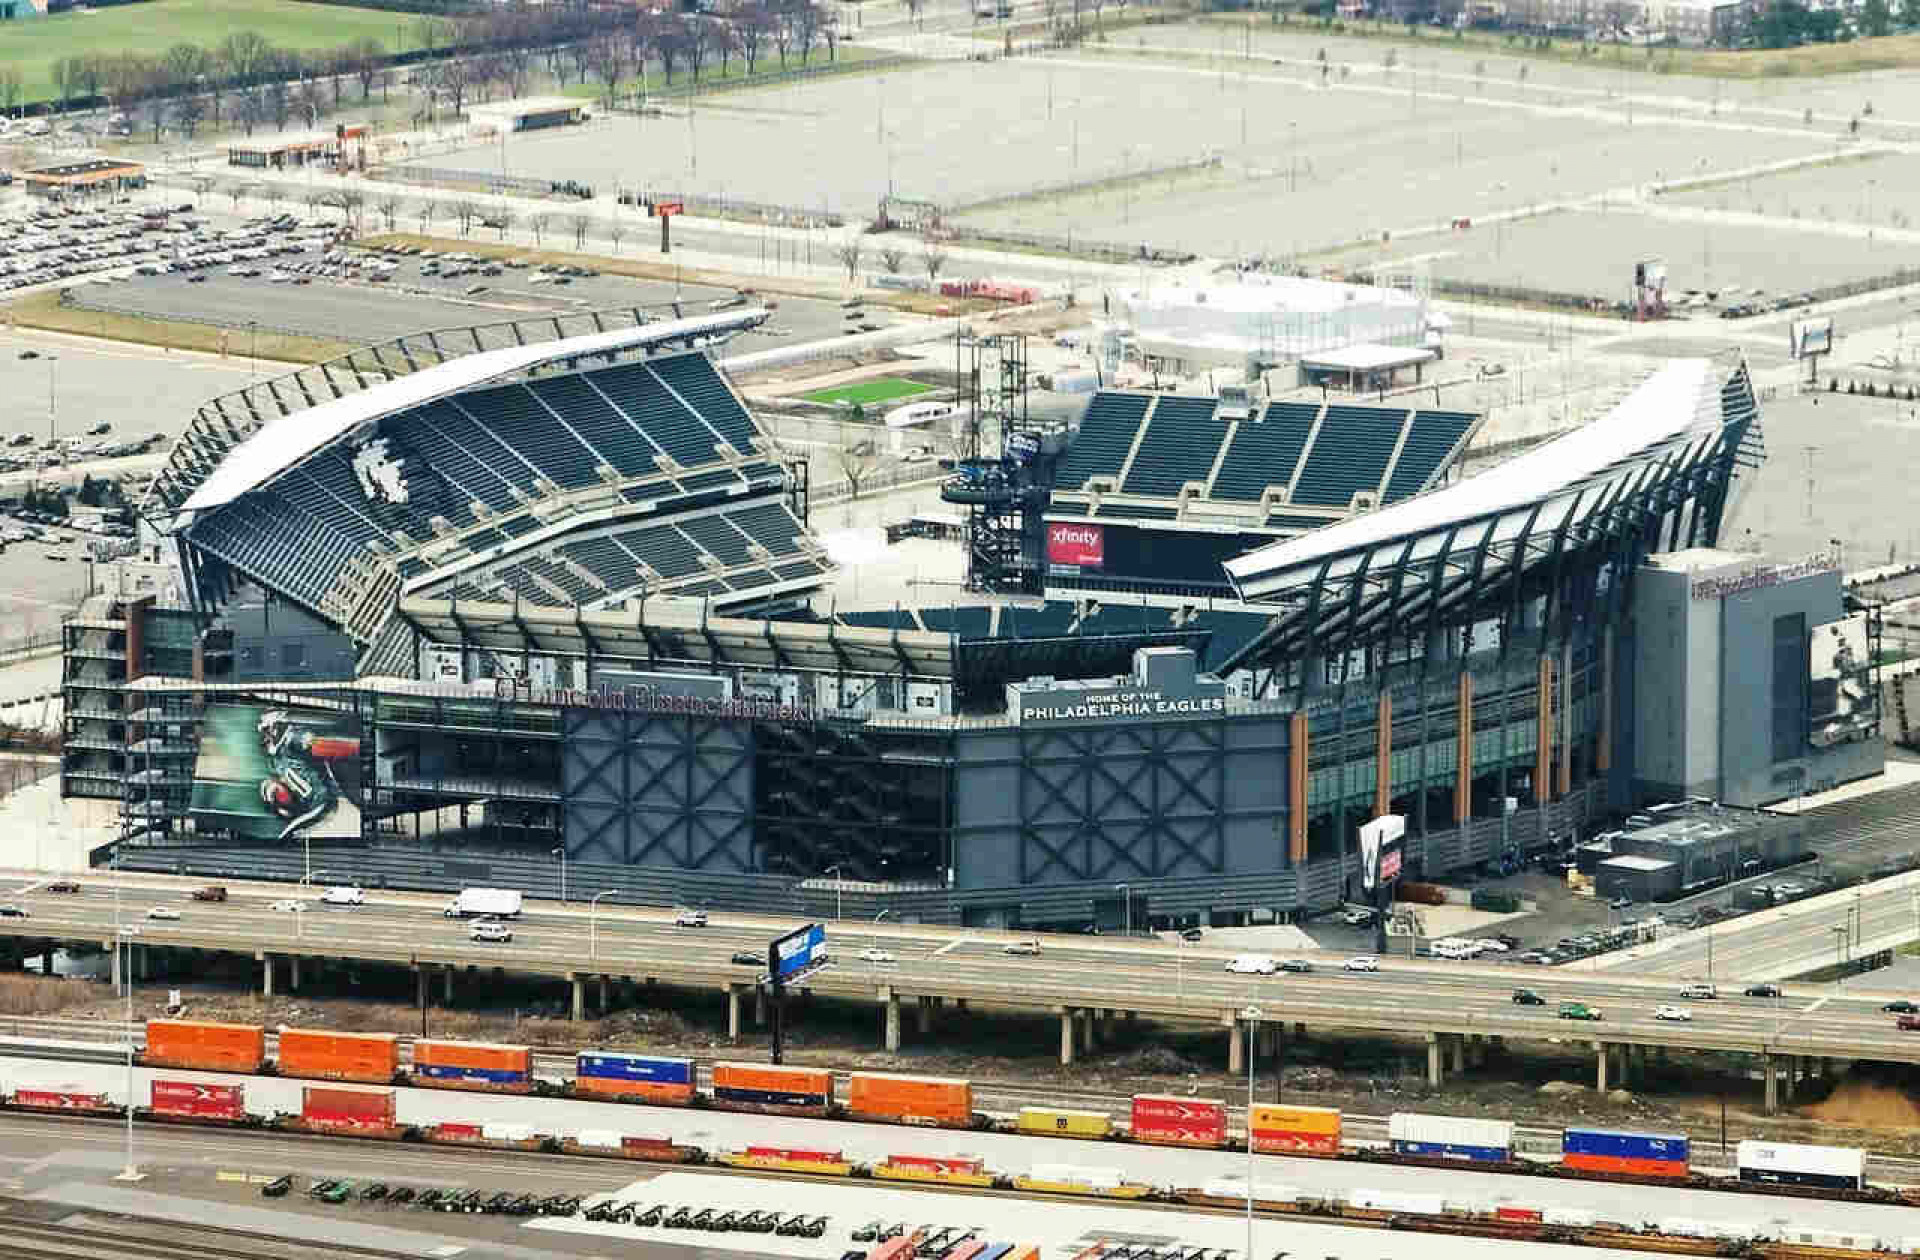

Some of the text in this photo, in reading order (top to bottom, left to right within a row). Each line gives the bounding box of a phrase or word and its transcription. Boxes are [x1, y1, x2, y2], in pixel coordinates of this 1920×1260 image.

[1086, 692, 1162, 703] HOME OF THE
[1023, 698, 1224, 720] PHILADELPHIA EAGLES
